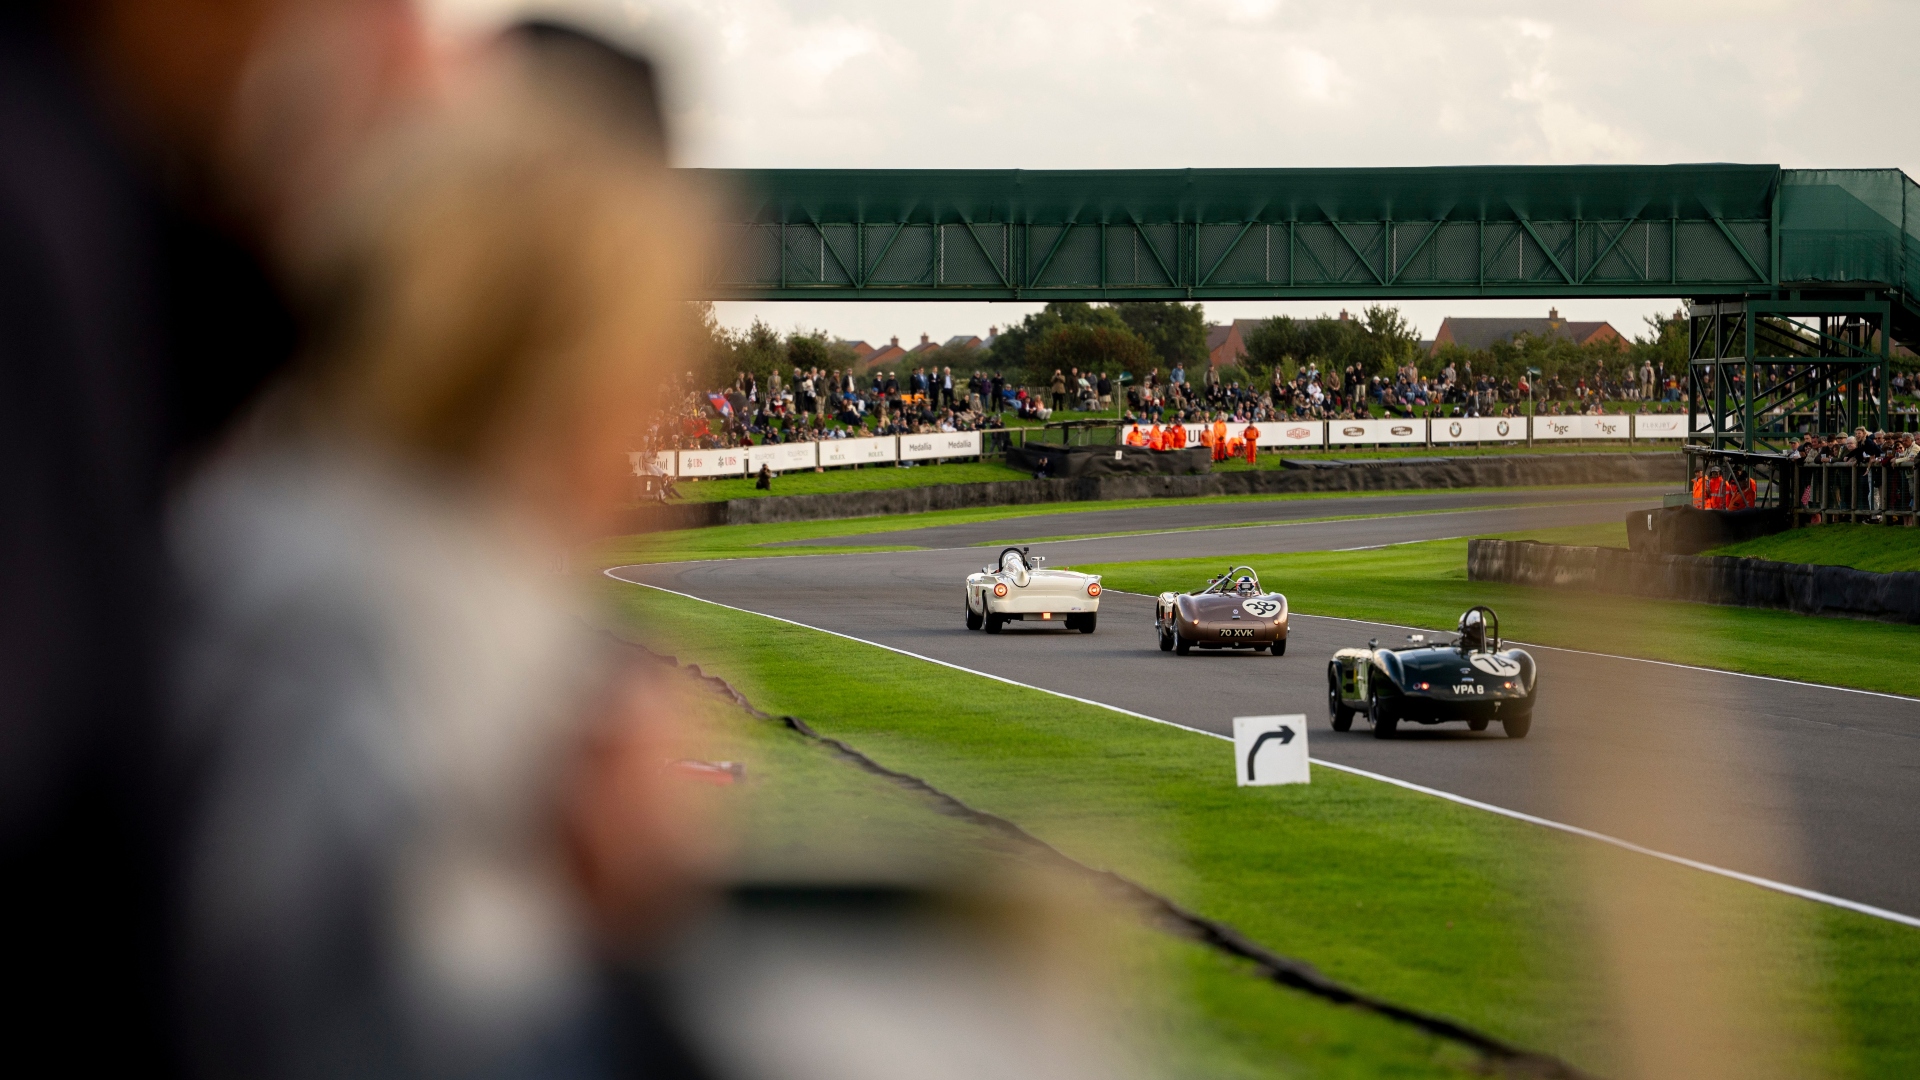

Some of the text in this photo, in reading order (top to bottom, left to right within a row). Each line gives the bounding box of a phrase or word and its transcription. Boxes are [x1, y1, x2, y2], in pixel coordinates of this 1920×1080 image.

[1554, 423, 1569, 435] bgc
[1602, 422, 1616, 434] bgc
[909, 442, 932, 452] Medallia
[948, 440, 971, 449] Medallia
[693, 458, 702, 467] UBS
[725, 457, 736, 466] UBS
[1246, 601, 1277, 615] 38
[1220, 629, 1254, 637] 70 XVK
[1474, 656, 1516, 673] 74
[1452, 685, 1475, 694] VPA
